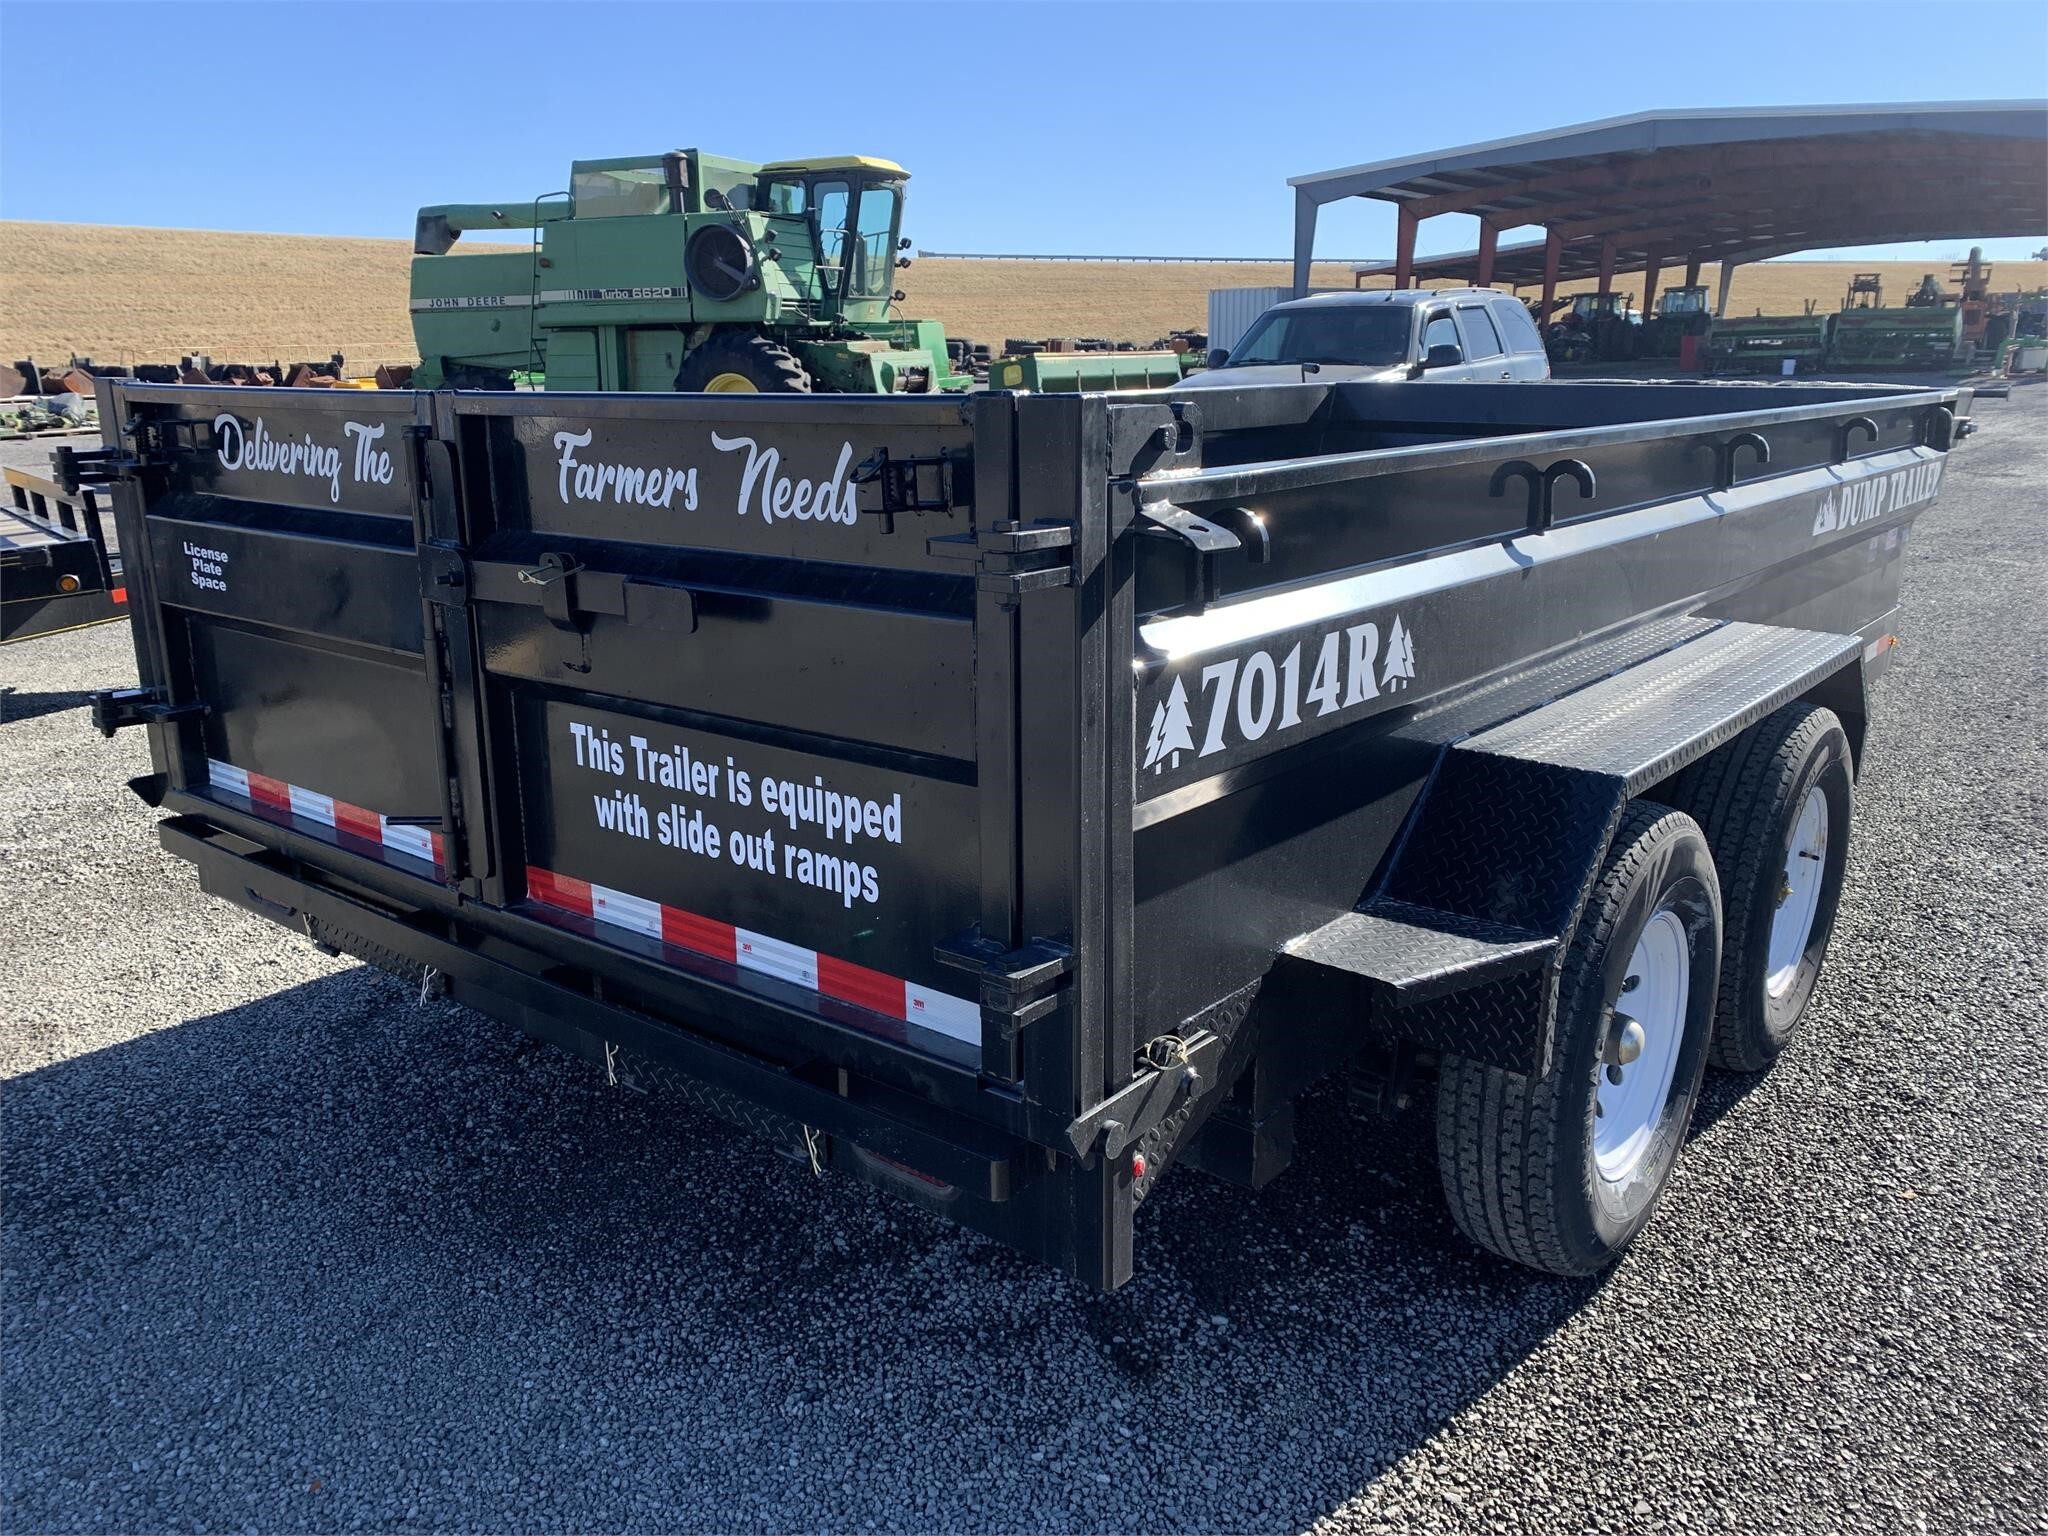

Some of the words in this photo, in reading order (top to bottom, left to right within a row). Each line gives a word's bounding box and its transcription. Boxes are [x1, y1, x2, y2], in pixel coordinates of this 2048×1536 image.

[429, 297, 459, 308] JOHN
[467, 296, 506, 306] DEERE
[600, 288, 628, 300] Turbo
[632, 287, 672, 298] 6620
[214, 413, 342, 503] Delivering
[344, 421, 394, 485] The
[553, 428, 699, 512] Farmers
[711, 428, 858, 525] Needs
[1836, 476, 1888, 531] DUMP
[1888, 461, 1942, 513] TRAILER
[183, 541, 229, 564] License
[191, 572, 227, 592] Space
[193, 558, 223, 576] Plate
[1199, 622, 1381, 758] 7014R
[569, 721, 625, 776] This
[630, 735, 719, 798] Trailer
[727, 757, 752, 807] is
[760, 776, 902, 845] equipped
[593, 790, 650, 840] with
[657, 805, 721, 859] slide
[729, 828, 776, 875] out
[784, 844, 880, 908] ramps
